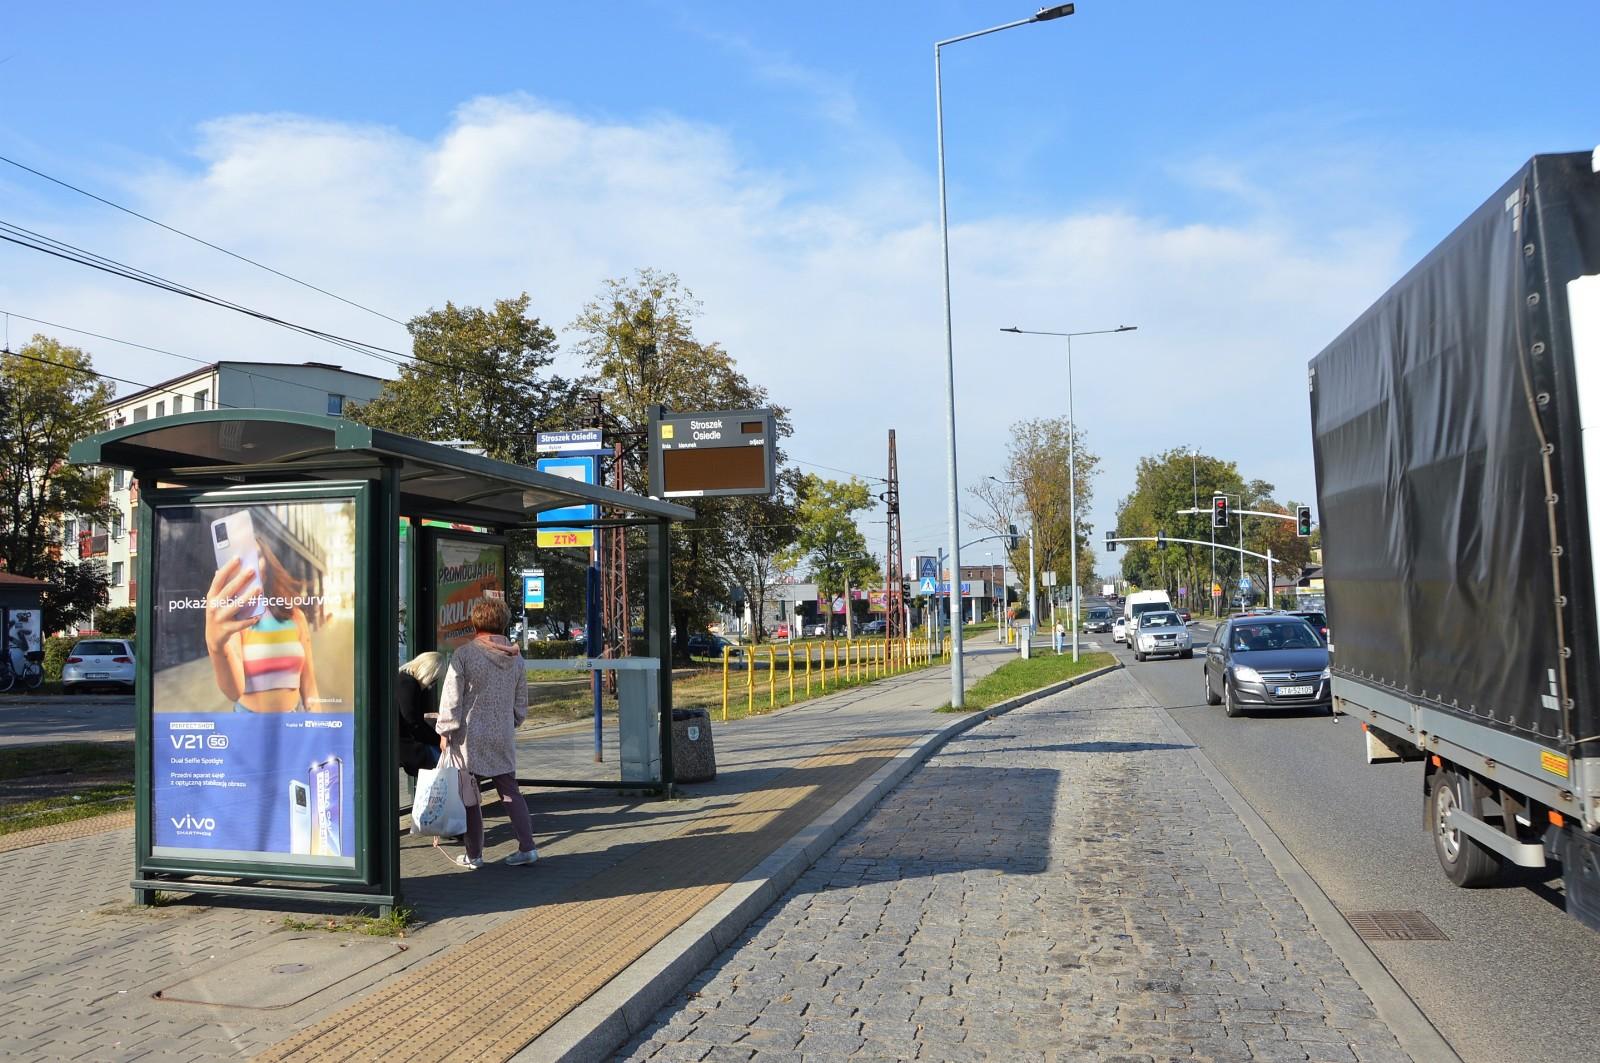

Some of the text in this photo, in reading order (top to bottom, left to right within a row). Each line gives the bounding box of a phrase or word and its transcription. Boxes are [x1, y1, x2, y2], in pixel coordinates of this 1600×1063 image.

[690, 419, 723, 430] Stroszek
[541, 432, 598, 443] Stroszek Osiedle
[692, 430, 721, 441] Osiedle
[553, 533, 577, 545] ZTM
[168, 596, 207, 612] pokaż
[210, 595, 245, 609] siebie
[170, 734, 226, 749] V21 5G
[170, 813, 216, 831] vivo
